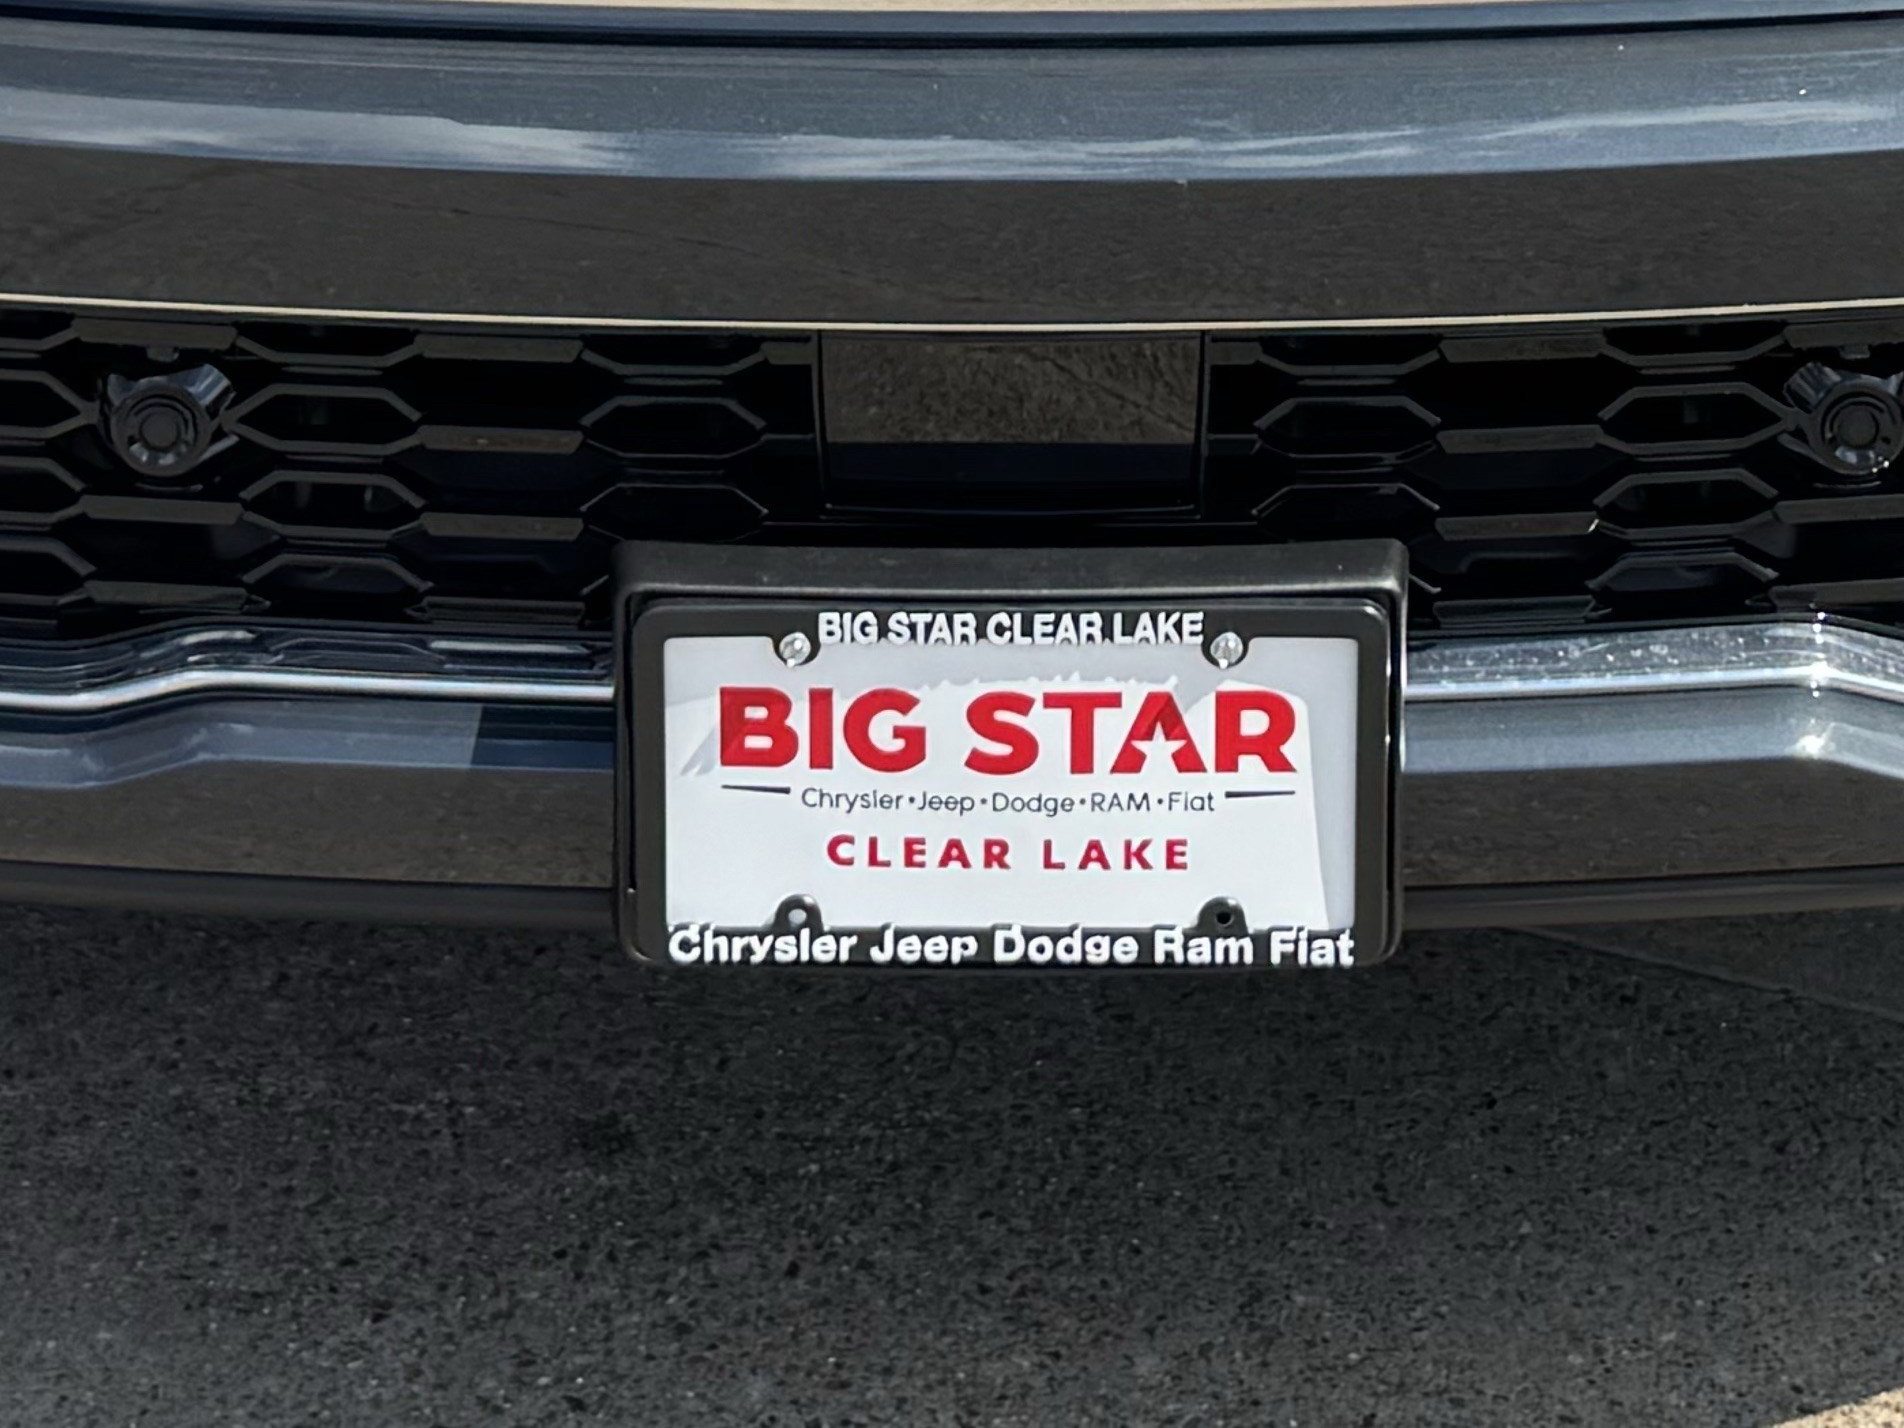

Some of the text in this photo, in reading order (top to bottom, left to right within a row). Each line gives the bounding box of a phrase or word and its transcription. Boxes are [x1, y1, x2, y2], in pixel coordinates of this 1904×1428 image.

[818, 611, 1204, 644] BIG STAR CLEAR LAKE
[719, 686, 1297, 775] BIG STAR
[801, 787, 1215, 817] Chrysler Jeep Dodge RAM Fiat
[826, 834, 1189, 870] CLEAR LAKE
[668, 924, 1355, 969] Chrysler Jeep Dodge Ram Fiat
